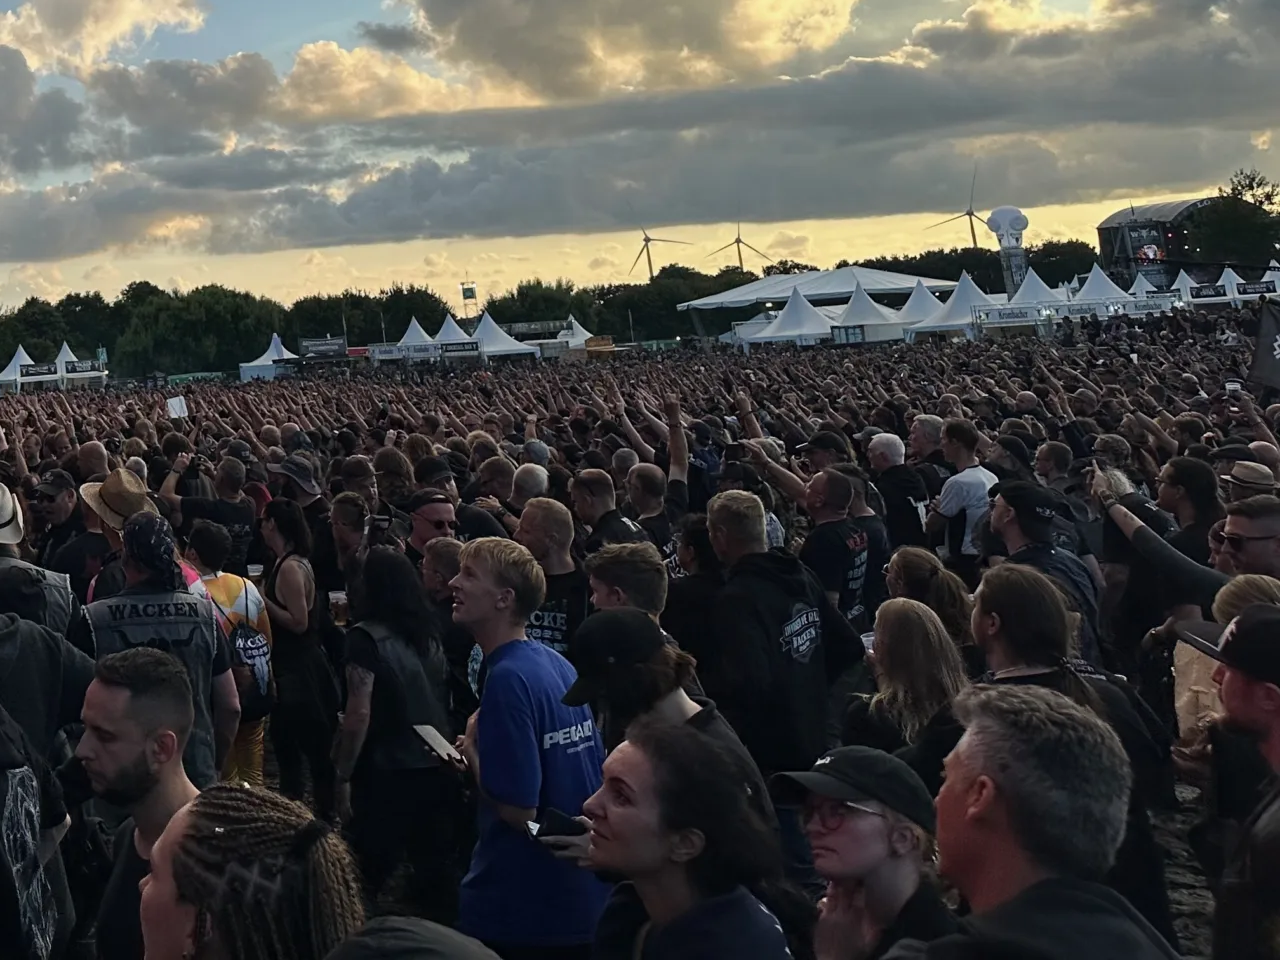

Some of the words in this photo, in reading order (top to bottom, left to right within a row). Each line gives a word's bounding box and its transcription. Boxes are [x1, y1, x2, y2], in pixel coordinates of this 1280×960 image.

[998, 309, 1028, 320] Krombacher
[107, 602, 200, 622] WACKEN
[526, 610, 568, 630] CKE
[526, 627, 562, 640] 2025
